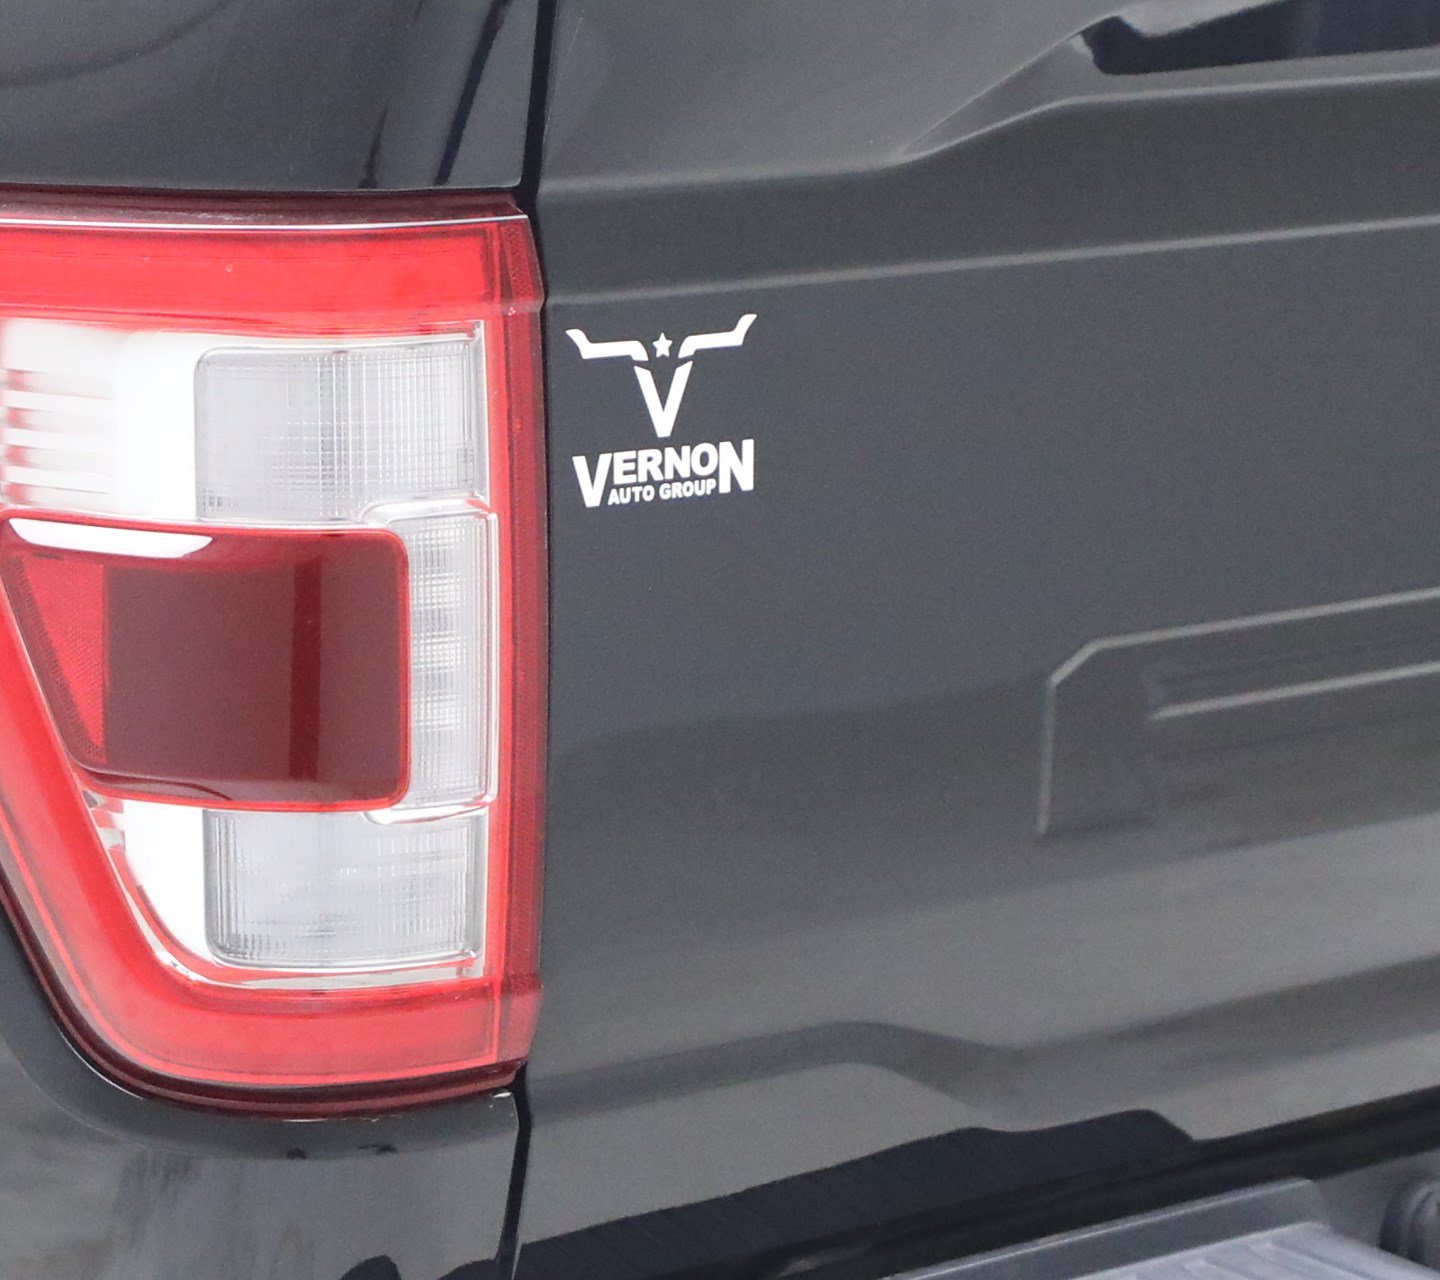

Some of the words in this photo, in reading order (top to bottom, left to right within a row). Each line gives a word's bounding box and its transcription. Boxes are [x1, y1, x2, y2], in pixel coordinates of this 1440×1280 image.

[572, 438, 755, 508] VERNON
[607, 485, 655, 505] AUTO
[658, 478, 717, 499] GROUP
